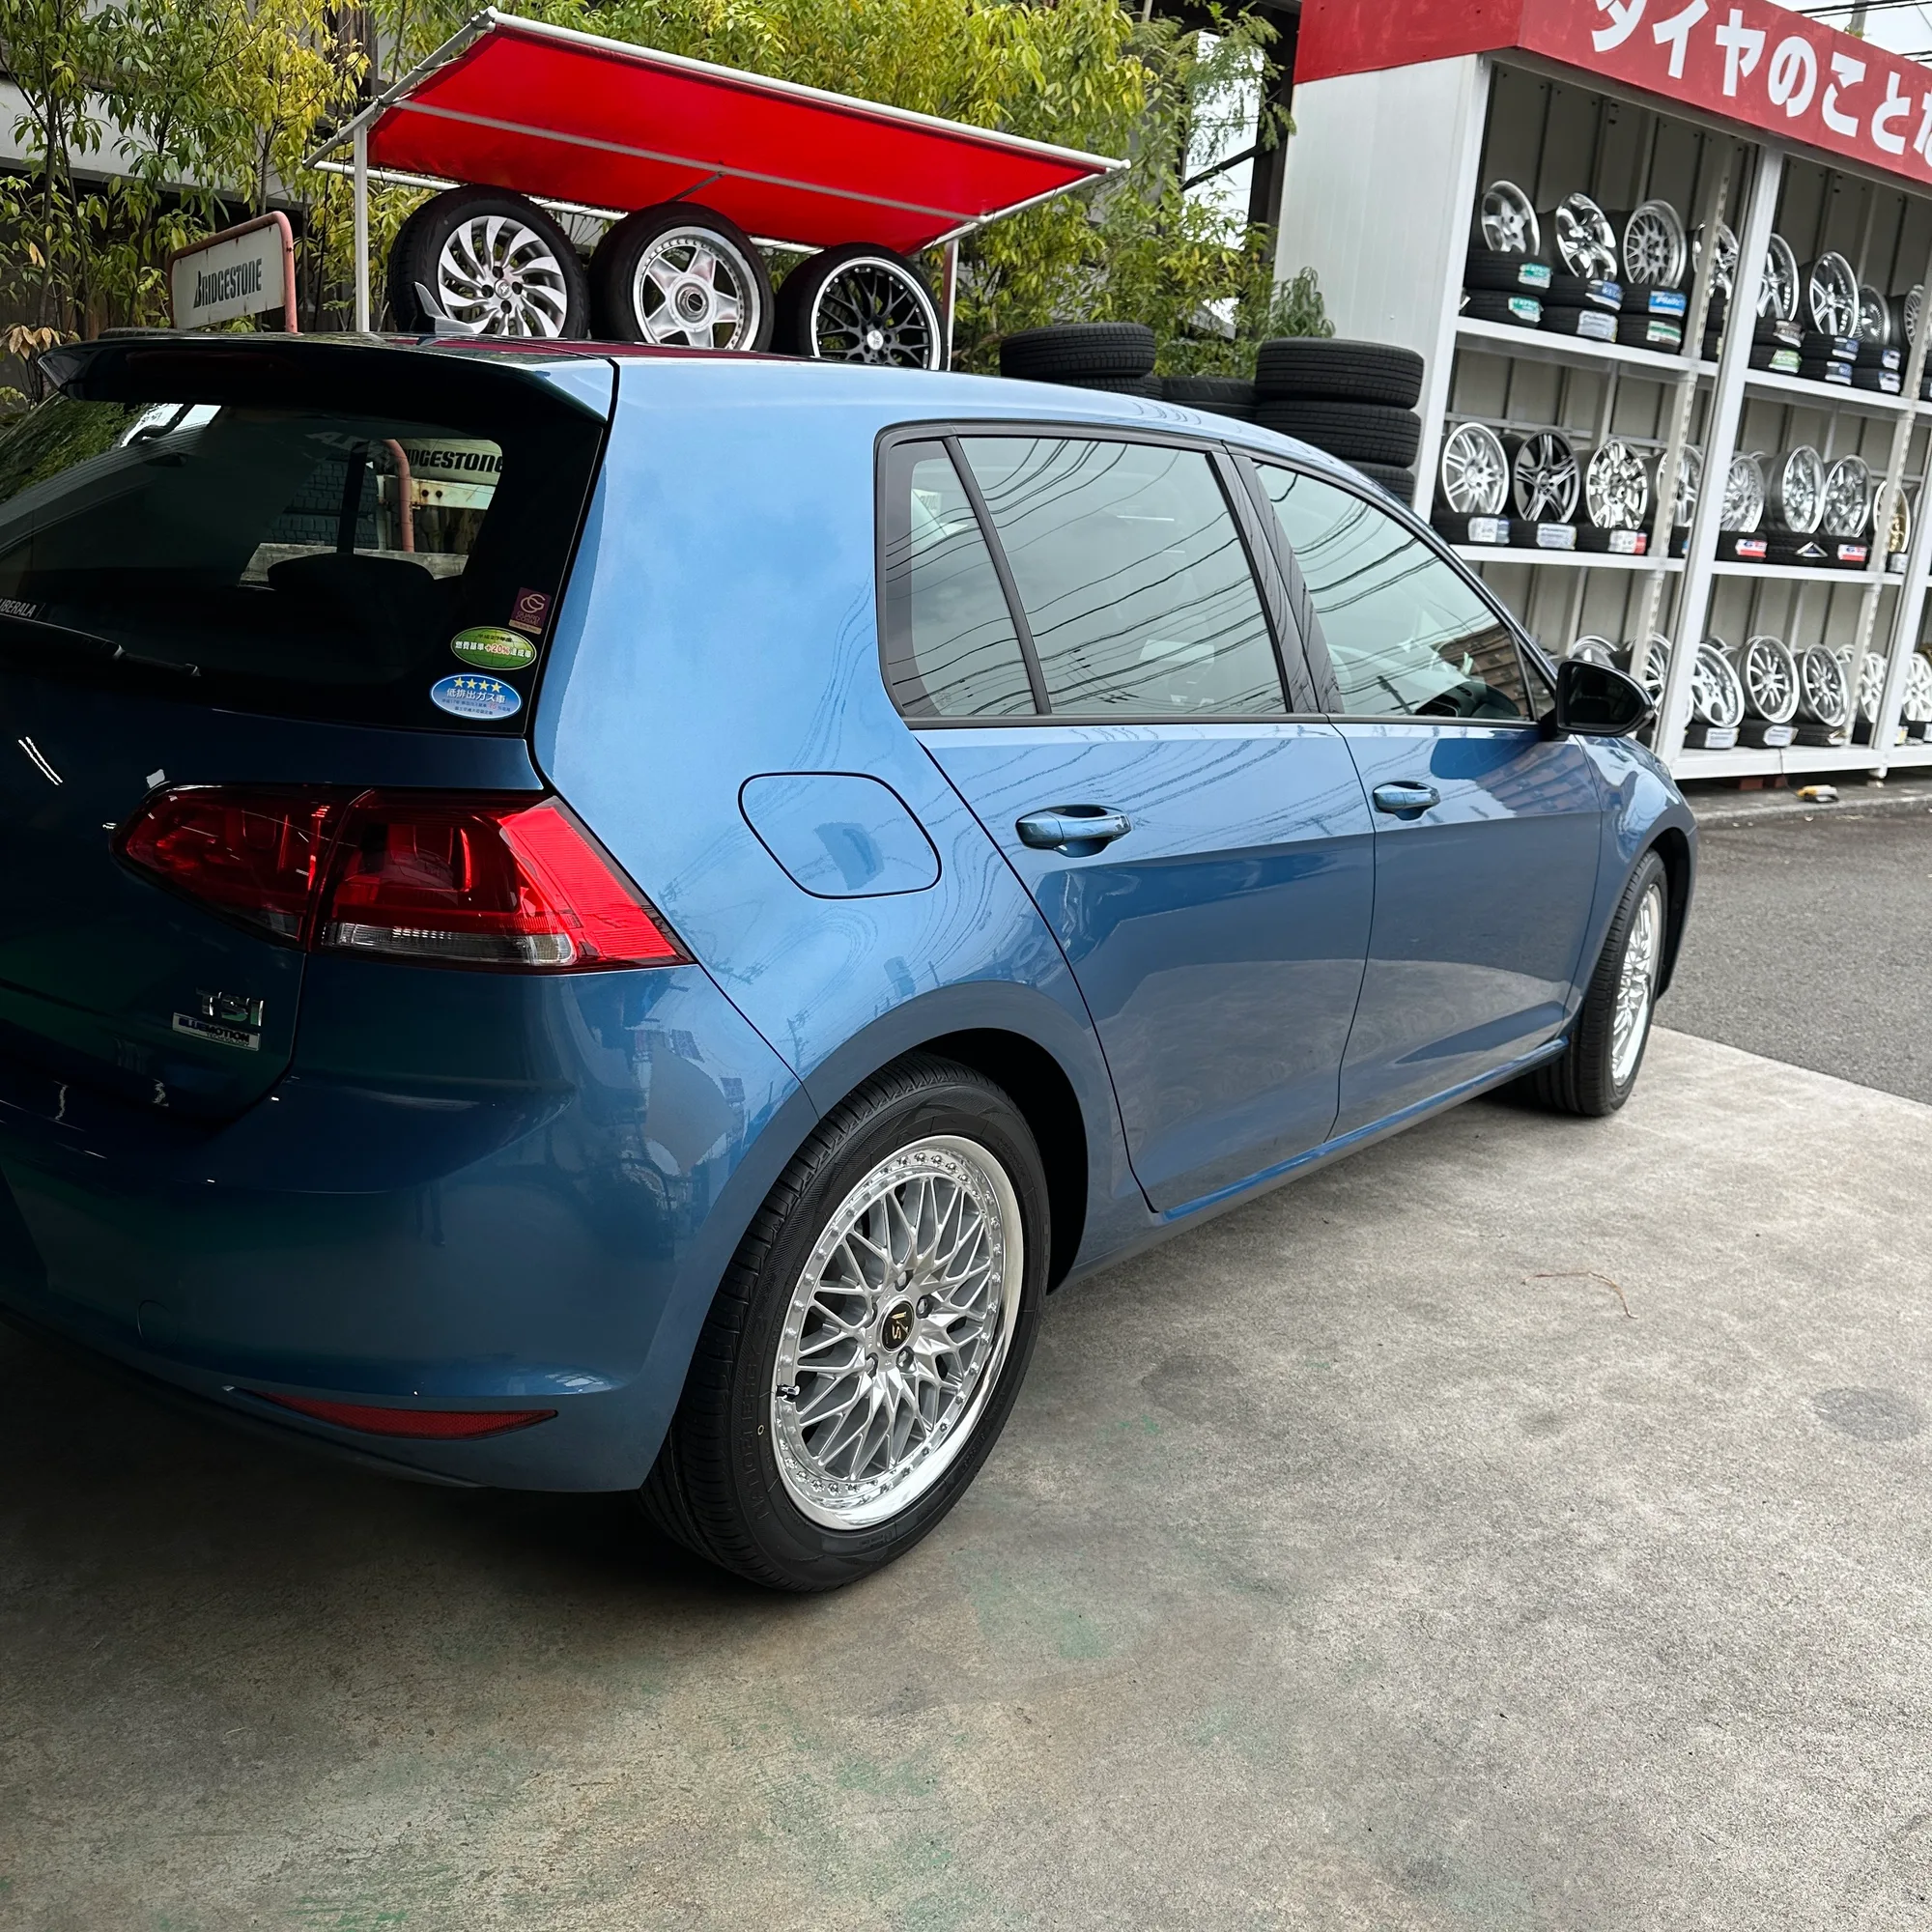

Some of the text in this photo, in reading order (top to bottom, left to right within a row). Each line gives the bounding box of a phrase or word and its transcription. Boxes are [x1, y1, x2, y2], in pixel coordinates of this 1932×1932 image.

[193, 258, 262, 308] BRIDGESTONE
[446, 688, 505, 703] 低排出ガス車
[196, 986, 264, 1026] TSI
